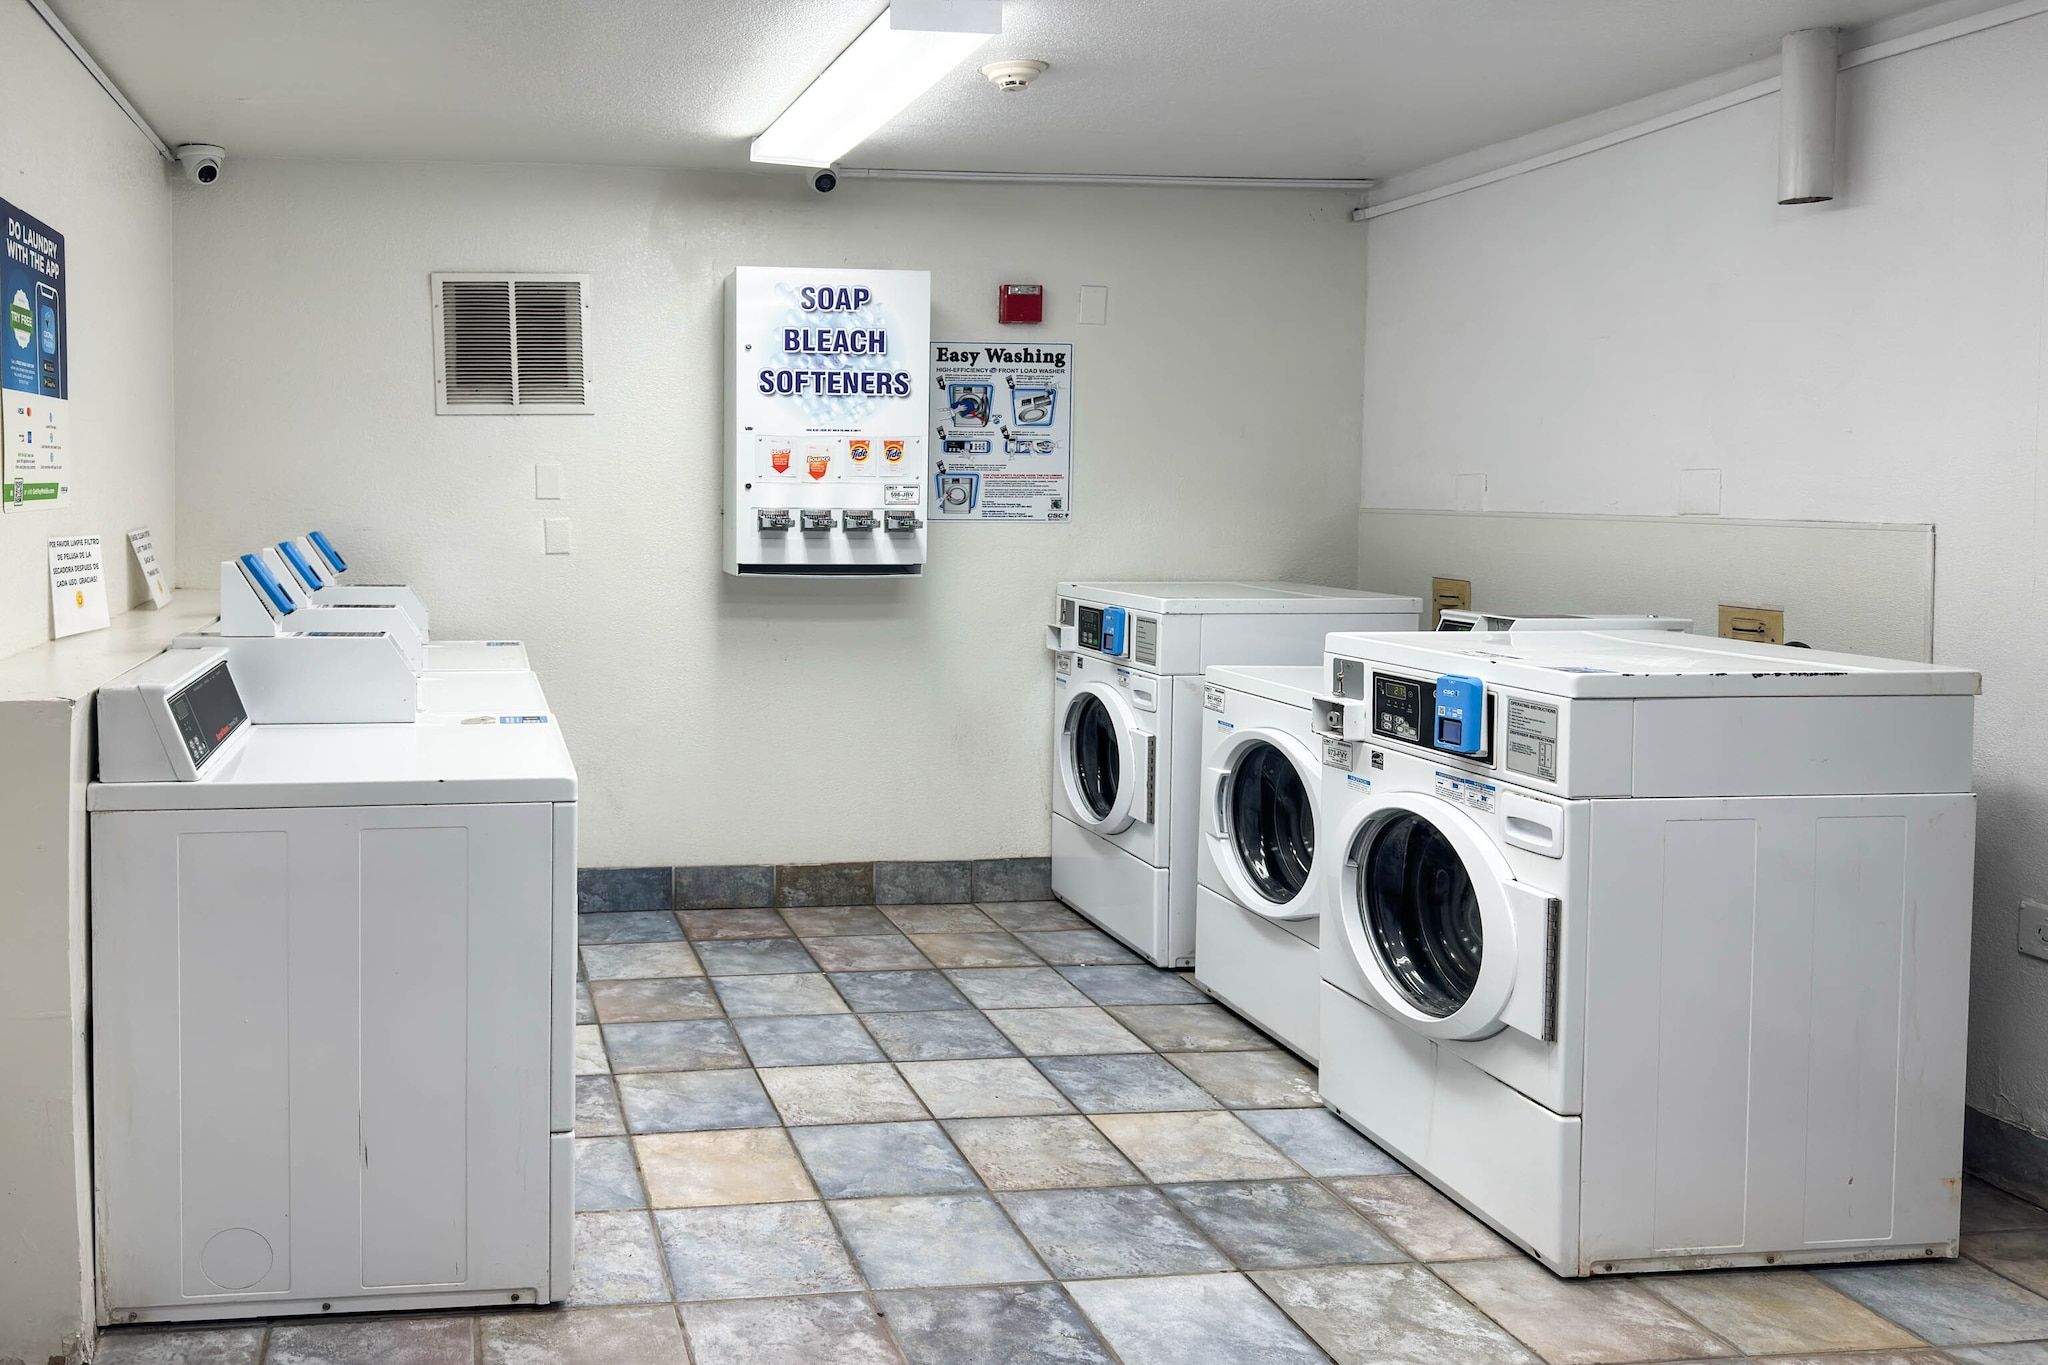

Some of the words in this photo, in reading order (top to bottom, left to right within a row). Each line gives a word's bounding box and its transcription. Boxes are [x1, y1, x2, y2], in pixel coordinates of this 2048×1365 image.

[9, 217, 21, 240] DO
[23, 225, 57, 260] LAUNDRY
[6, 237, 28, 266] WITH
[30, 249, 45, 273] THE
[46, 259, 60, 280] APP
[801, 286, 870, 310] SOAP
[11, 311, 20, 323] TRY
[20, 314, 33, 328] FREE
[784, 328, 885, 353] BLEACH
[936, 347, 980, 367] Easy
[984, 347, 1066, 368] Washing
[759, 370, 909, 395] SOFTENERS
[851, 448, 868, 459] Tide
[885, 449, 902, 460] Tide
[70, 539, 83, 547] LIMPIE
[57, 553, 63, 561] DE
[63, 552, 78, 560] PELUSA
[53, 566, 74, 575] SECADORA
[74, 563, 92, 572] DESPUES
[93, 562, 99, 570] DE
[56, 579, 67, 588] CADA
[79, 575, 97, 585] GRACIAS!
